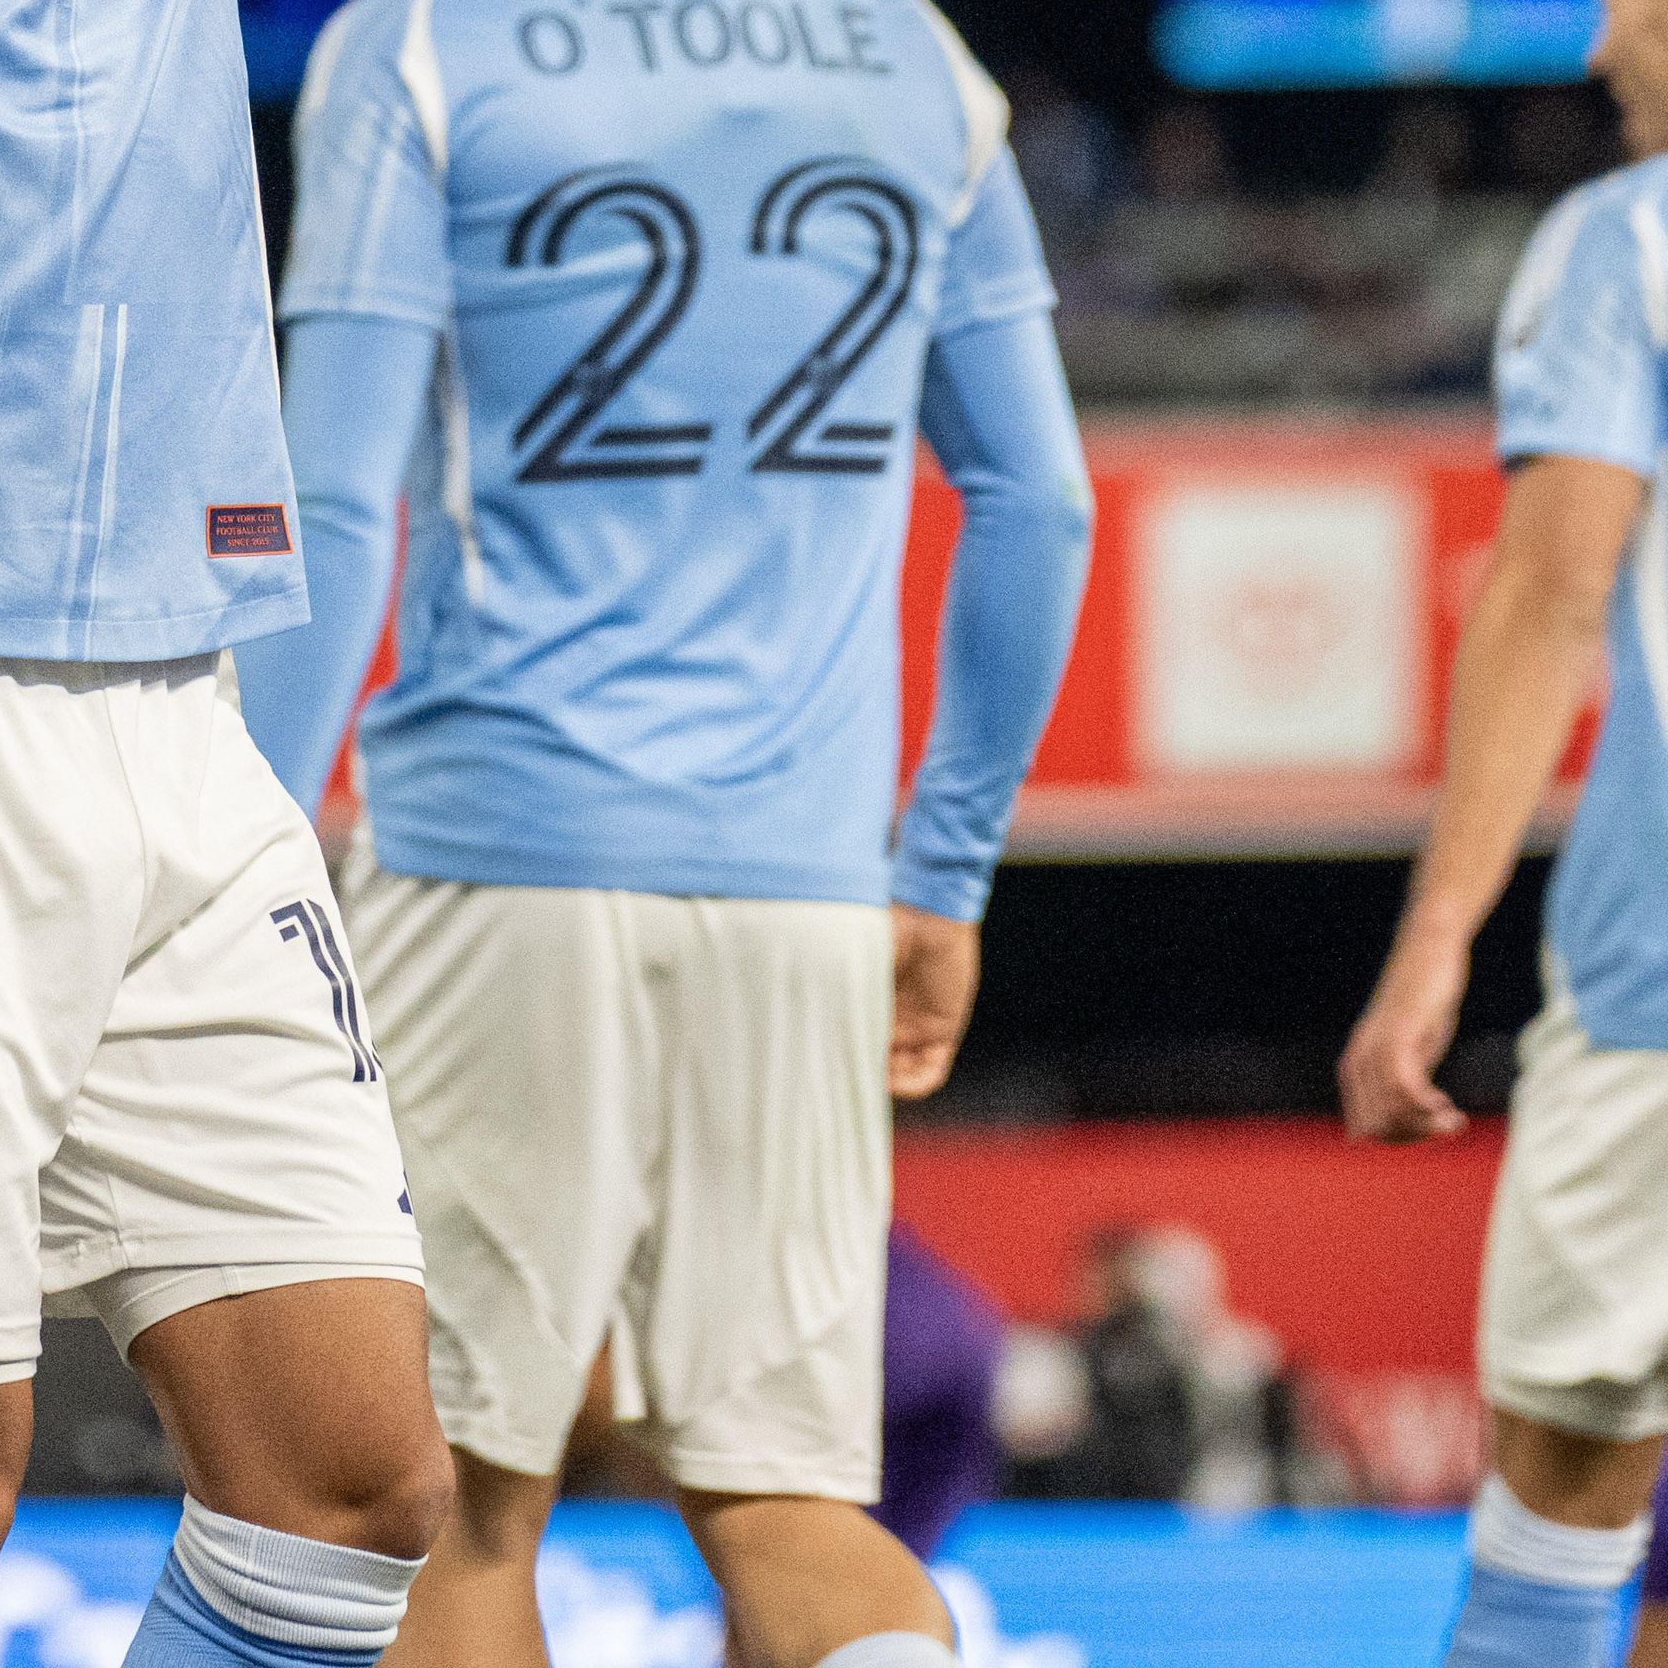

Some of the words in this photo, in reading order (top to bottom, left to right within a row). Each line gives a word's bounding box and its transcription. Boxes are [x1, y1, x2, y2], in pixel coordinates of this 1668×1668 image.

[505, 156, 919, 484] 22
[217, 515, 234, 524] NEW
[236, 515, 256, 523] YORK
[258, 513, 276, 522] CITY
[215, 526, 254, 536] FOOTBALL
